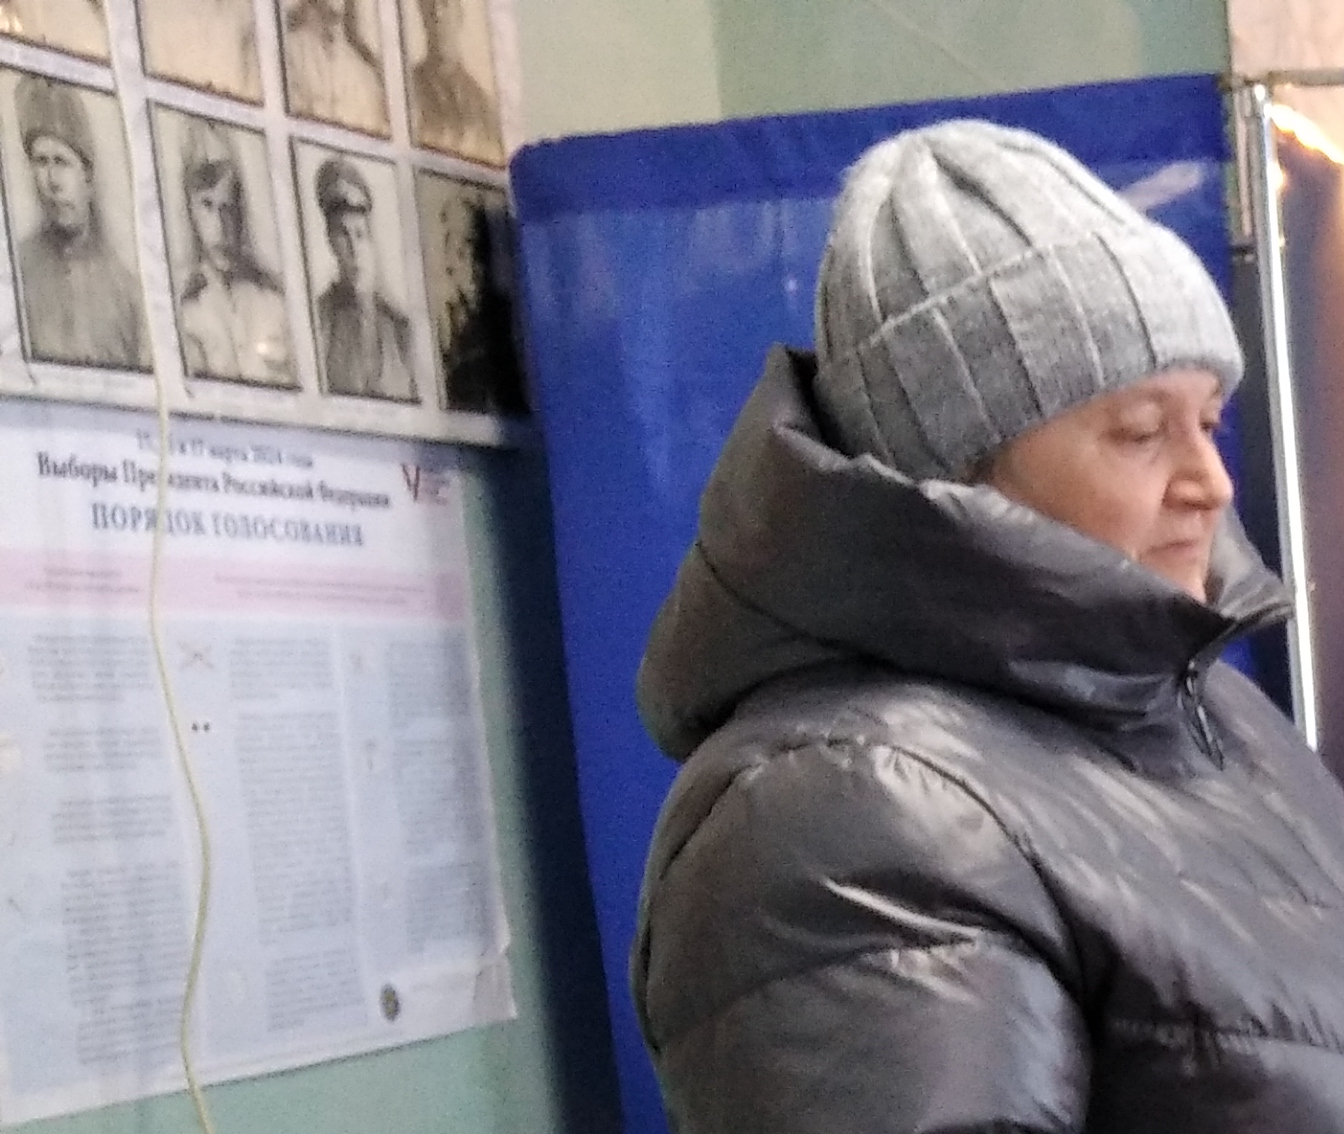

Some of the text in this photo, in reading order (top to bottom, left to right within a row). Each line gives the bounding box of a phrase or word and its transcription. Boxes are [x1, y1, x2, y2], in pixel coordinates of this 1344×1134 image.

[37, 451, 118, 487] Выборы
[123, 459, 219, 492] Преидента
[211, 512, 363, 545] ГОЛОСОВАНИЯ
